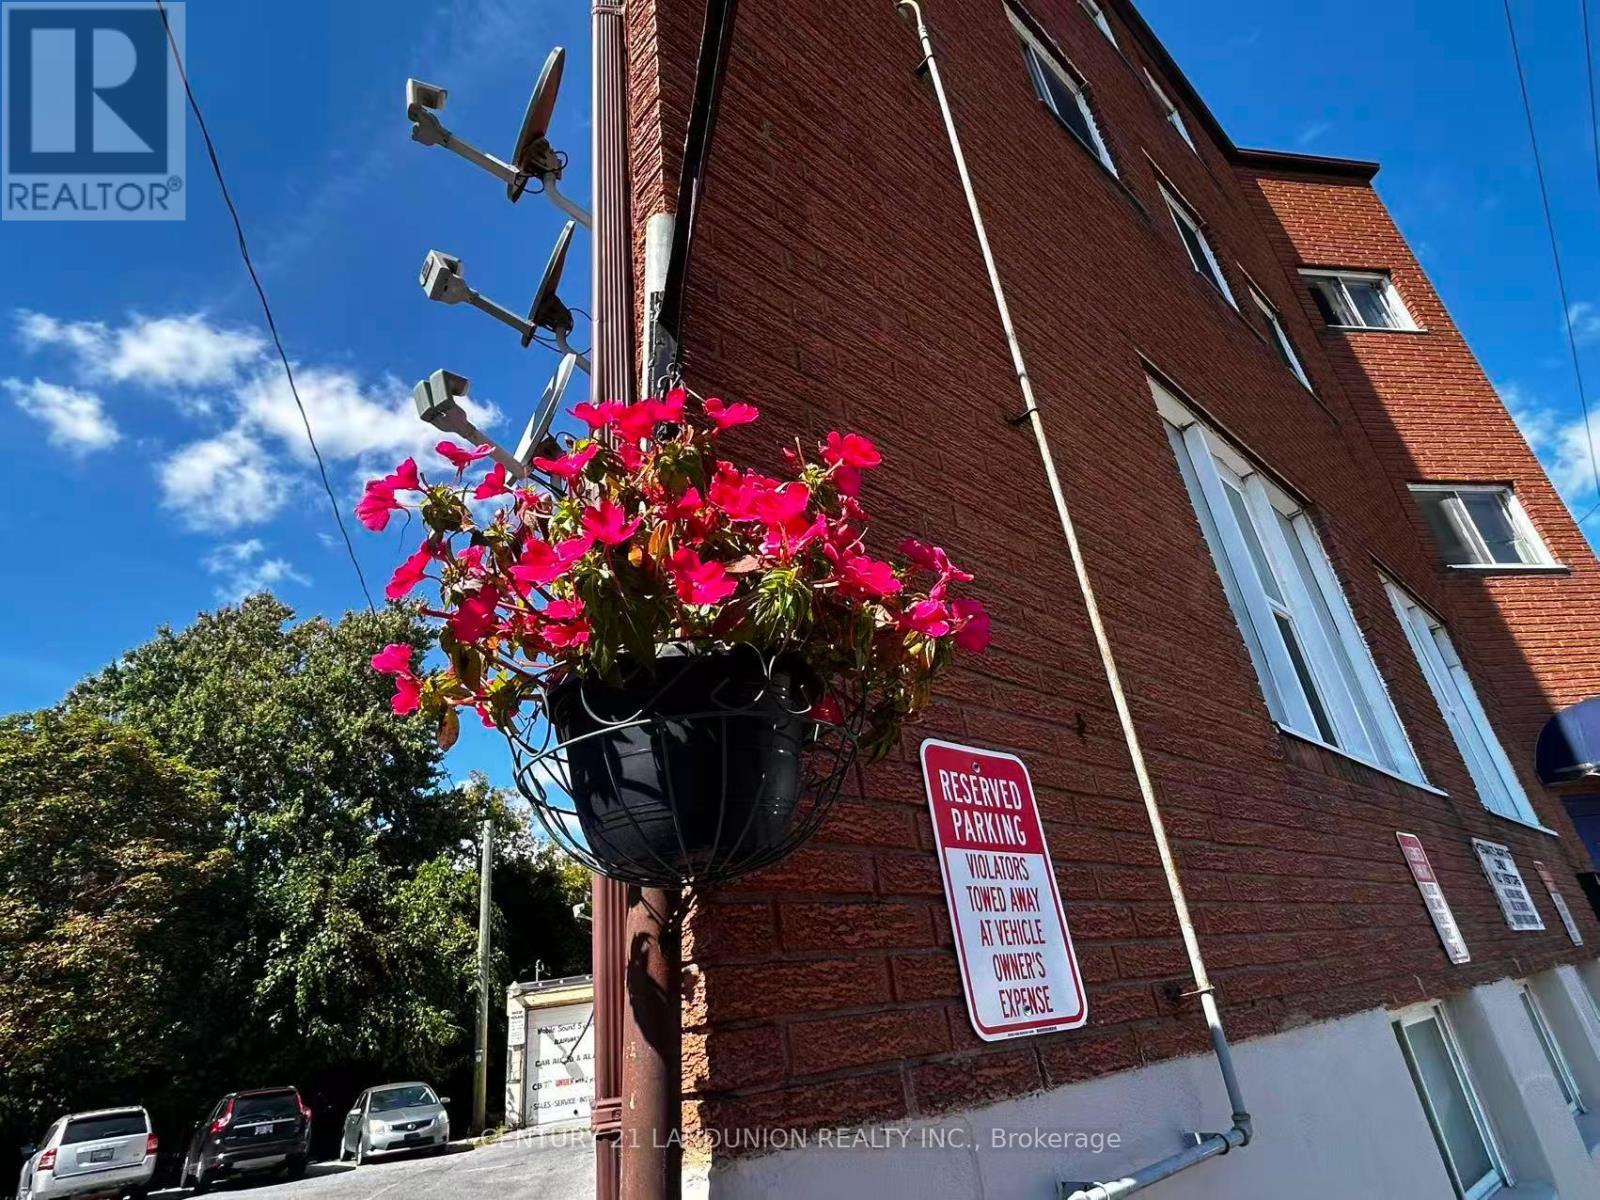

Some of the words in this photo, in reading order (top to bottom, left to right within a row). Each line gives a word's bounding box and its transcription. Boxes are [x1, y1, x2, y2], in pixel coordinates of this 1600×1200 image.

[938, 769, 1022, 810] RESERVED
[951, 808, 1027, 846] PARKING
[965, 853, 1030, 881] VIOLATORS
[966, 886, 1007, 913] TOWED
[1009, 887, 1041, 913] AWAY
[980, 919, 996, 947] AT
[998, 919, 1046, 946] VEHICLE
[992, 952, 1046, 982] OWNER'S
[998, 985, 1054, 1019] EXPENSE
